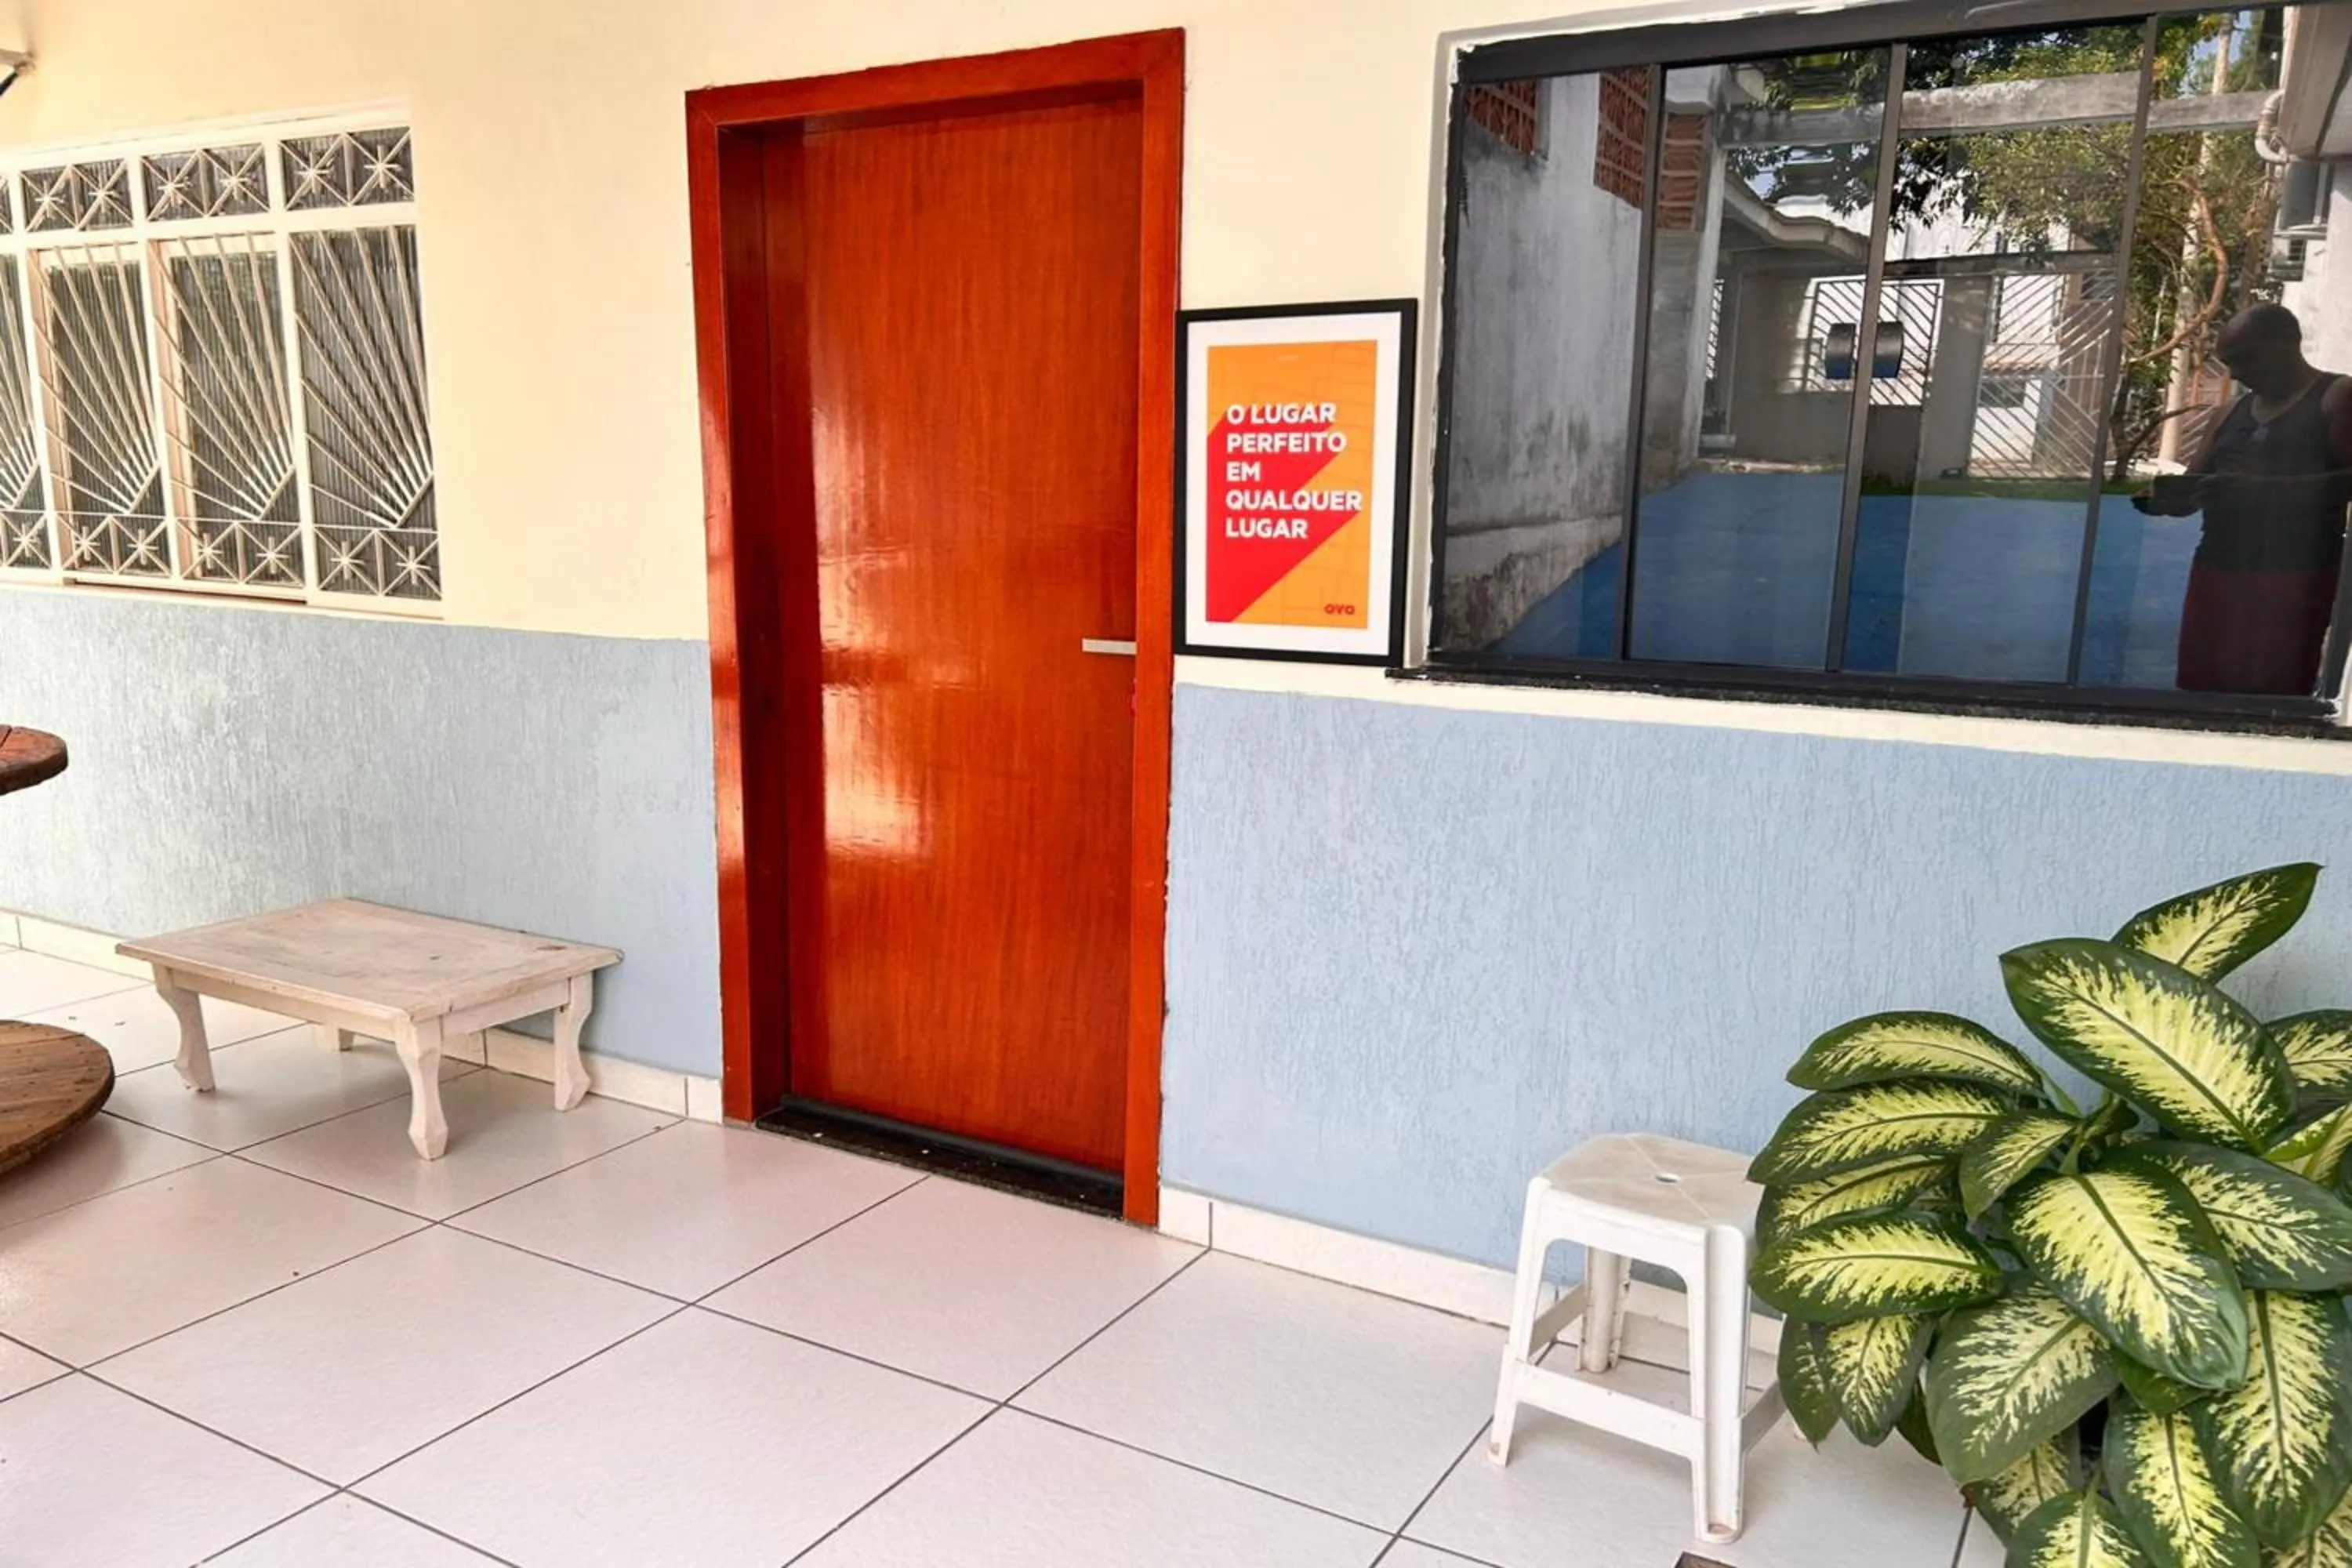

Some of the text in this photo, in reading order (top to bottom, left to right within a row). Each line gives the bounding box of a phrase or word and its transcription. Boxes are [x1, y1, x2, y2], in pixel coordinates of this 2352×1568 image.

[1227, 403, 1337, 424] O LUGAR
[1227, 432, 1347, 452] PERFEITO
[1227, 463, 1261, 482] EM
[1226, 491, 1363, 510] QUALQUER
[1226, 519, 1308, 538] LUGAR
